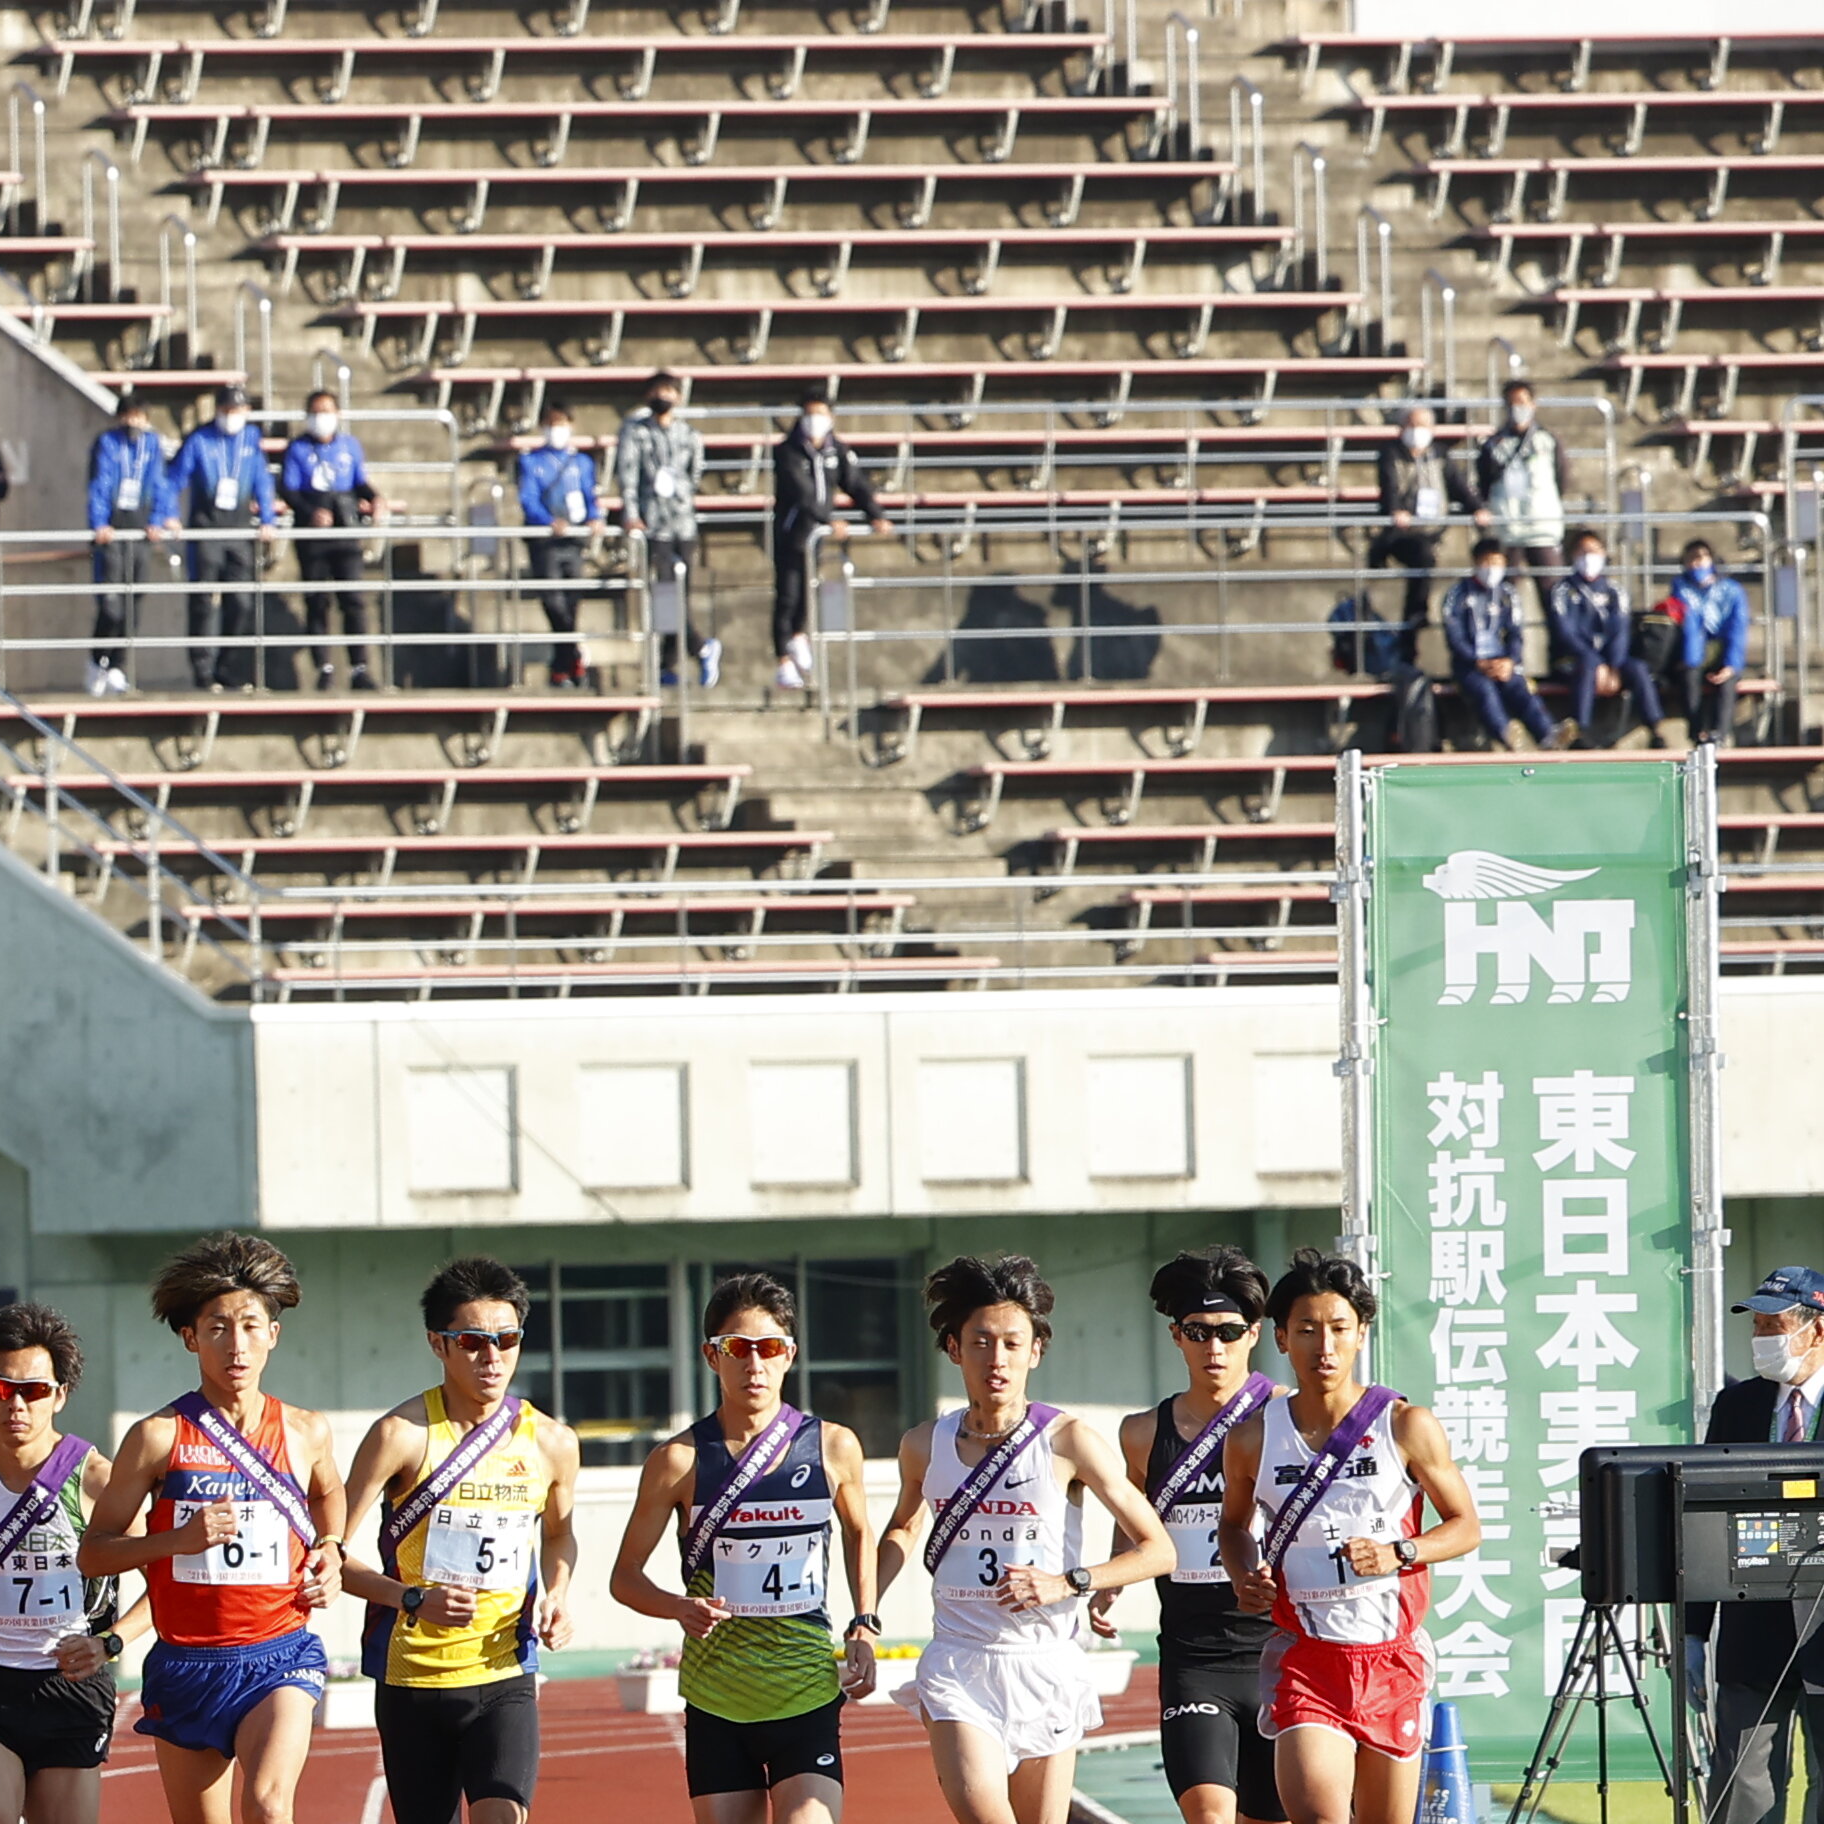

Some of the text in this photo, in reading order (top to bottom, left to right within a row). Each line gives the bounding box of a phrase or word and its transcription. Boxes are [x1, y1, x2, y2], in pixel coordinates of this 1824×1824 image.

[1273, 1456, 1380, 1486] 富通
[459, 1482, 528, 1503] 日立物流
[437, 1509, 530, 1530] 日立物流
[934, 1498, 1039, 1516] HNDA
[223, 1530, 279, 1569] 6-1
[475, 1537, 519, 1574] 5-1
[718, 1537, 818, 1559] ヤクルト
[761, 1563, 816, 1601] 4-1
[12, 1577, 71, 1615] 7-1
[1163, 1702, 1220, 1720] GMO
